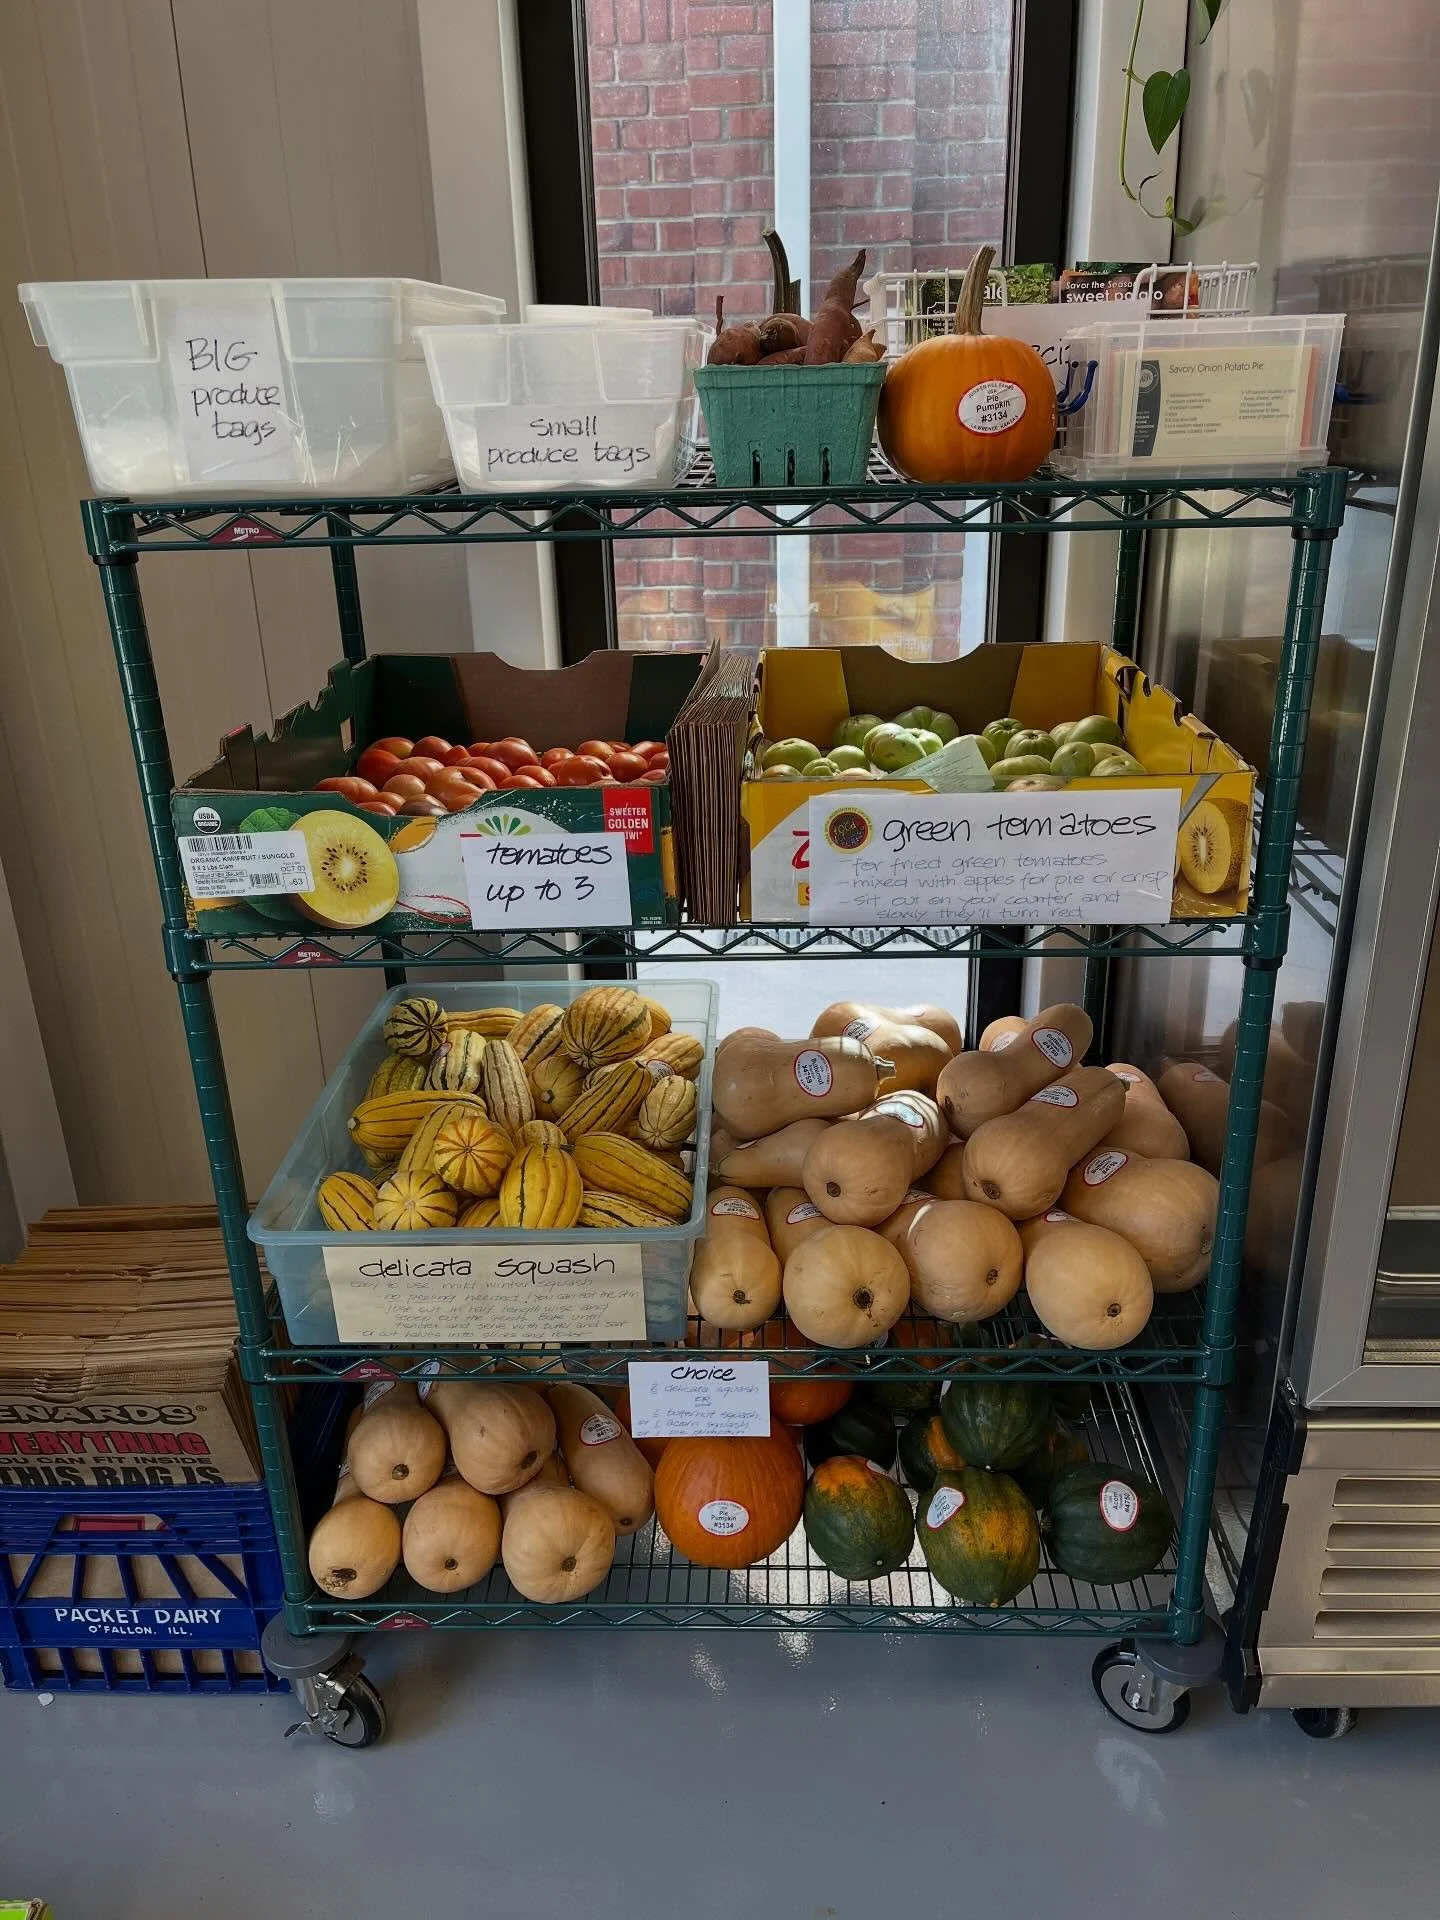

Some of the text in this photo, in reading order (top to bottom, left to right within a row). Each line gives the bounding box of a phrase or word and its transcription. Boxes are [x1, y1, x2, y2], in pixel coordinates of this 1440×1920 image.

[982, 282, 1003, 300] ale
[1065, 279, 1137, 289] Savor the Seaso
[1066, 289, 1164, 303] sweet poao
[185, 337, 258, 371] BIG
[1168, 361, 1264, 375] Savory Onion Potato Pie
[191, 383, 280, 417] produce
[976, 400, 1011, 412] Pumpkin
[986, 395, 999, 403] Pie
[981, 410, 1008, 424] #3134
[212, 410, 277, 446] bags
[530, 415, 597, 437] small
[488, 441, 650, 472] produce bags
[233, 527, 260, 535] METRO
[198, 812, 215, 820] USDA
[609, 807, 647, 816] SWEETER
[608, 818, 649, 830] GOLDEN
[883, 819, 971, 852] green
[986, 813, 1157, 840] tomatoes
[222, 854, 257, 862] KIWIFRUIT
[262, 852, 295, 860] SUNGOLD
[486, 842, 613, 866] tomatoes
[890, 856, 942, 876] fried
[951, 856, 1006, 876] green
[1014, 852, 1108, 868] tomatoes
[853, 870, 1169, 893] mixed with apples for pie or crisp
[486, 875, 595, 912] up to 3
[891, 894, 920, 907] out
[928, 895, 951, 904] on
[958, 893, 999, 911] your
[1081, 889, 1121, 904] and
[876, 905, 1083, 922] slowly they'll turn red
[297, 951, 321, 959] METRO
[359, 1252, 616, 1285] delicata squash
[671, 1365, 736, 1381] choice
[92, 1456, 126, 1464] FIT
[132, 1456, 213, 1465] INSIDE
[0, 1466, 225, 1486] THIS BAG IS
[711, 1514, 737, 1522] Pumpkin
[54, 1608, 222, 1624] PACKET DAIRY
